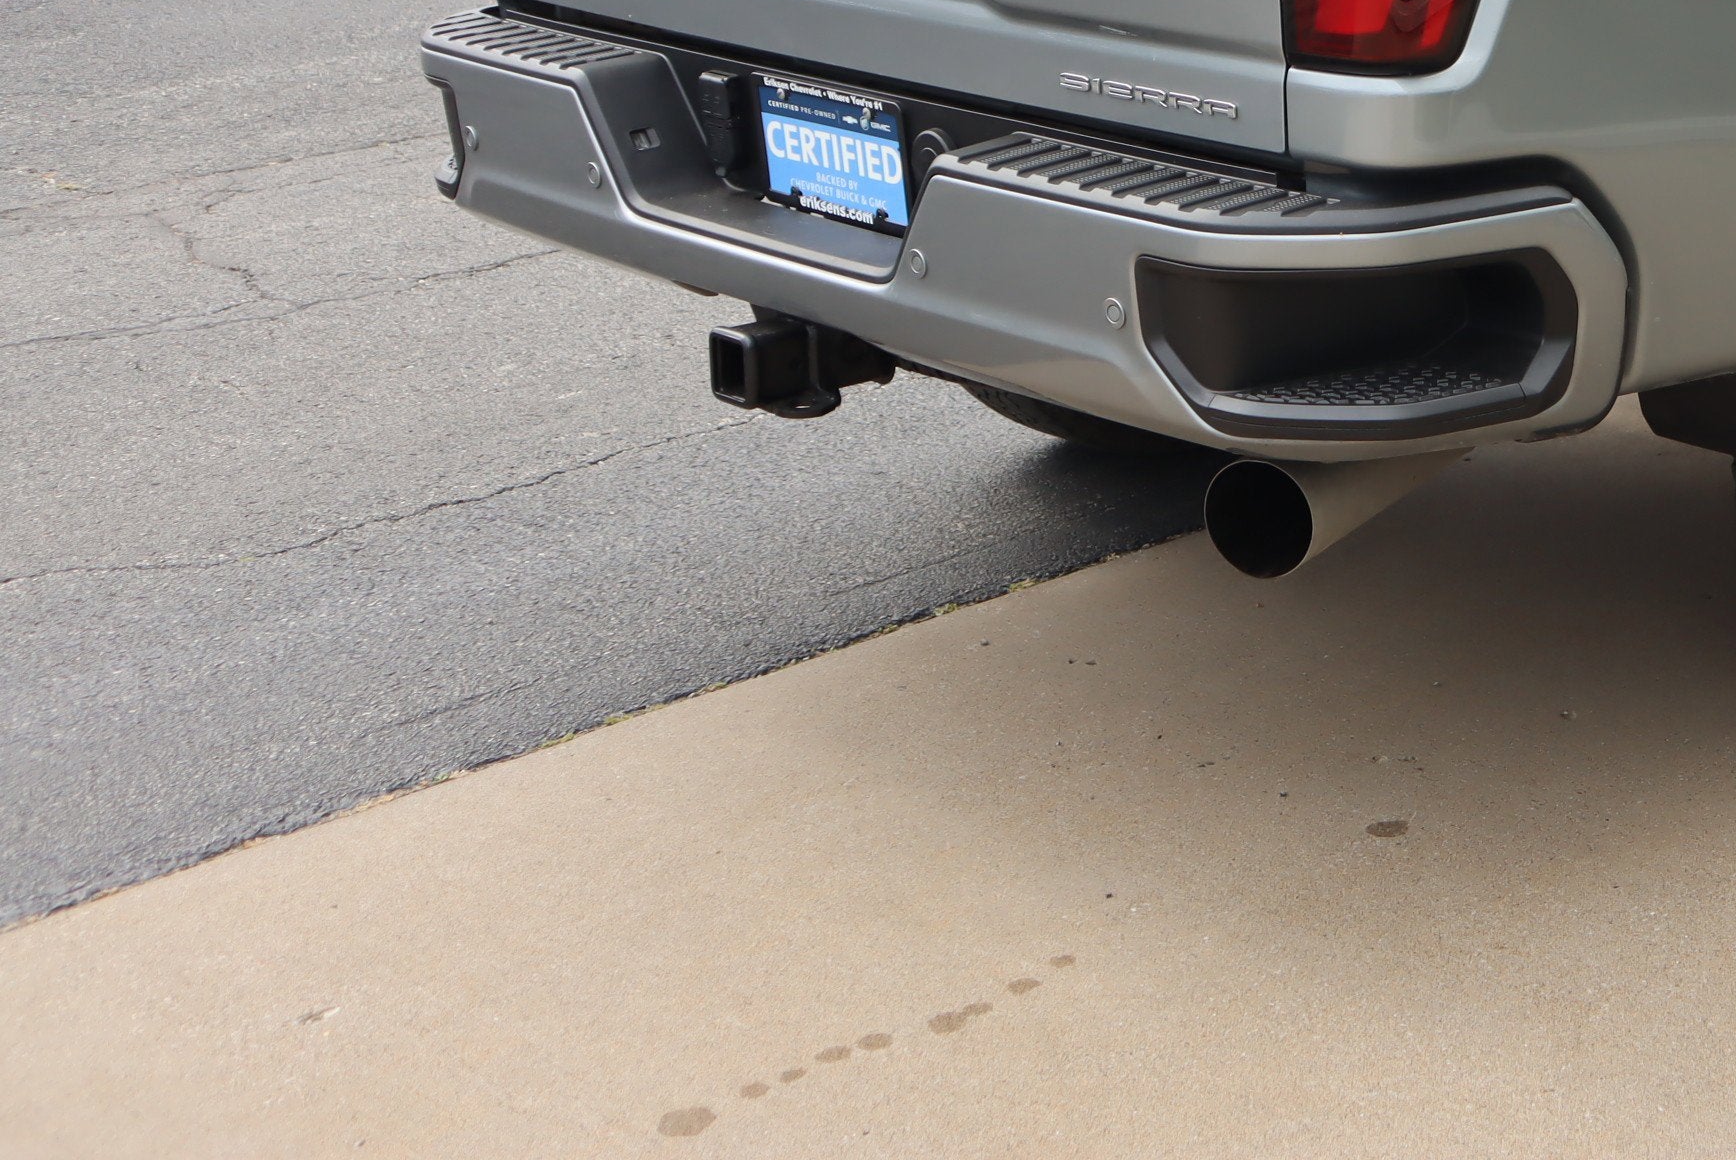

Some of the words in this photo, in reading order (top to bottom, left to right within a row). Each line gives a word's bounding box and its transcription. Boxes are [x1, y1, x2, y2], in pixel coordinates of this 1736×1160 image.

[767, 100, 800, 112] CERTIFIED
[800, 106, 836, 120] PRE-OWNED
[1060, 72, 1238, 119] SIERRA
[766, 121, 902, 184] CERTIFIED
[790, 178, 834, 197] CHEVROLET
[836, 189, 860, 204] BUICK
[861, 195, 868, 206] &
[868, 197, 888, 211] GMC
[816, 172, 847, 188] BACKED
[848, 179, 859, 191] BY
[800, 195, 874, 225] eriksens.com
